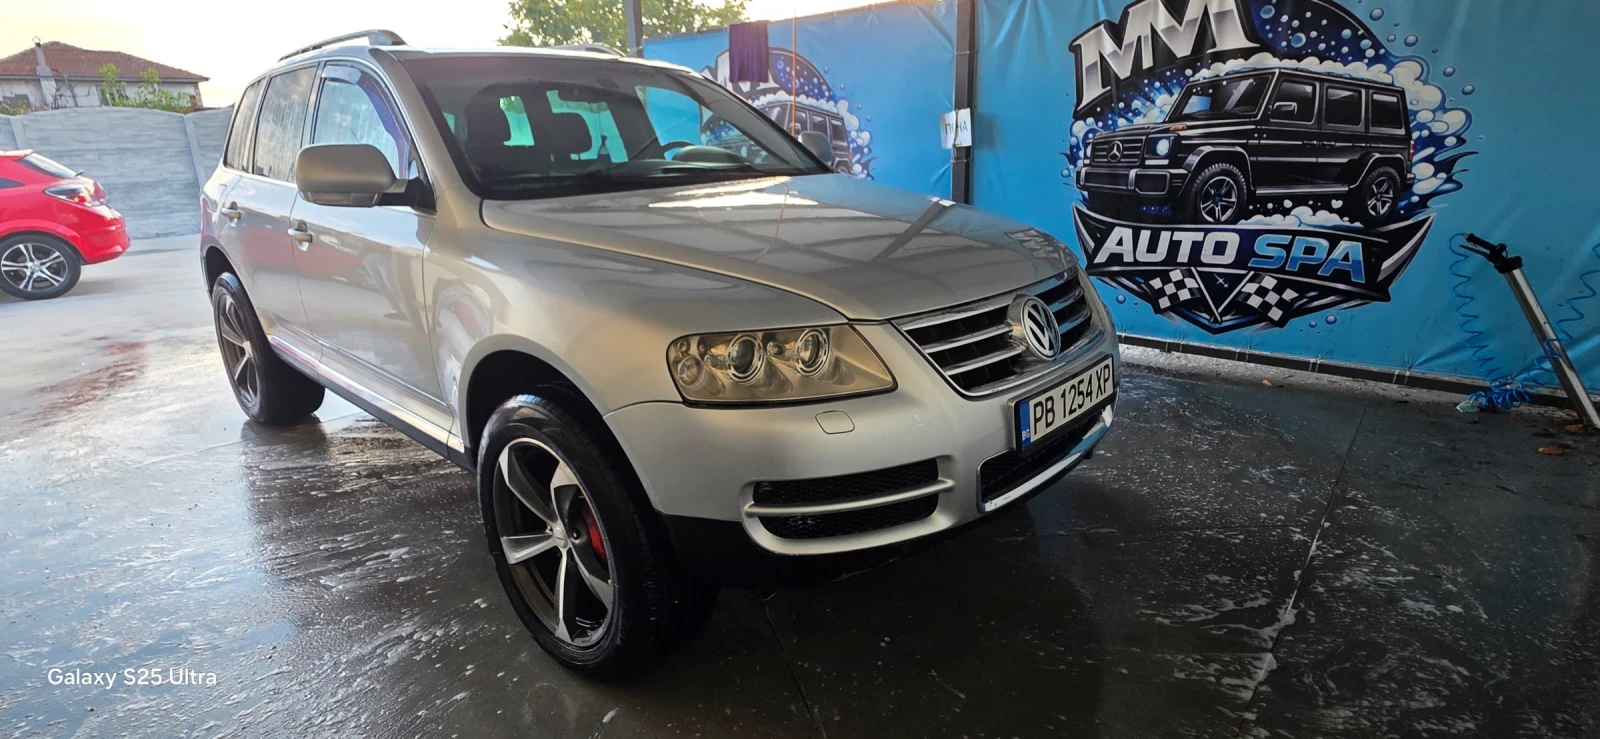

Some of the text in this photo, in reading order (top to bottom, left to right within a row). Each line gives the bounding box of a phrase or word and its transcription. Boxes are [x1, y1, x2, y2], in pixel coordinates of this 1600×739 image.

[1077, 0, 1260, 110] MM
[1094, 226, 1366, 283] AUTO SPA
[1033, 364, 1111, 435] PB 1254 XP
[1021, 430, 1031, 441] BG
